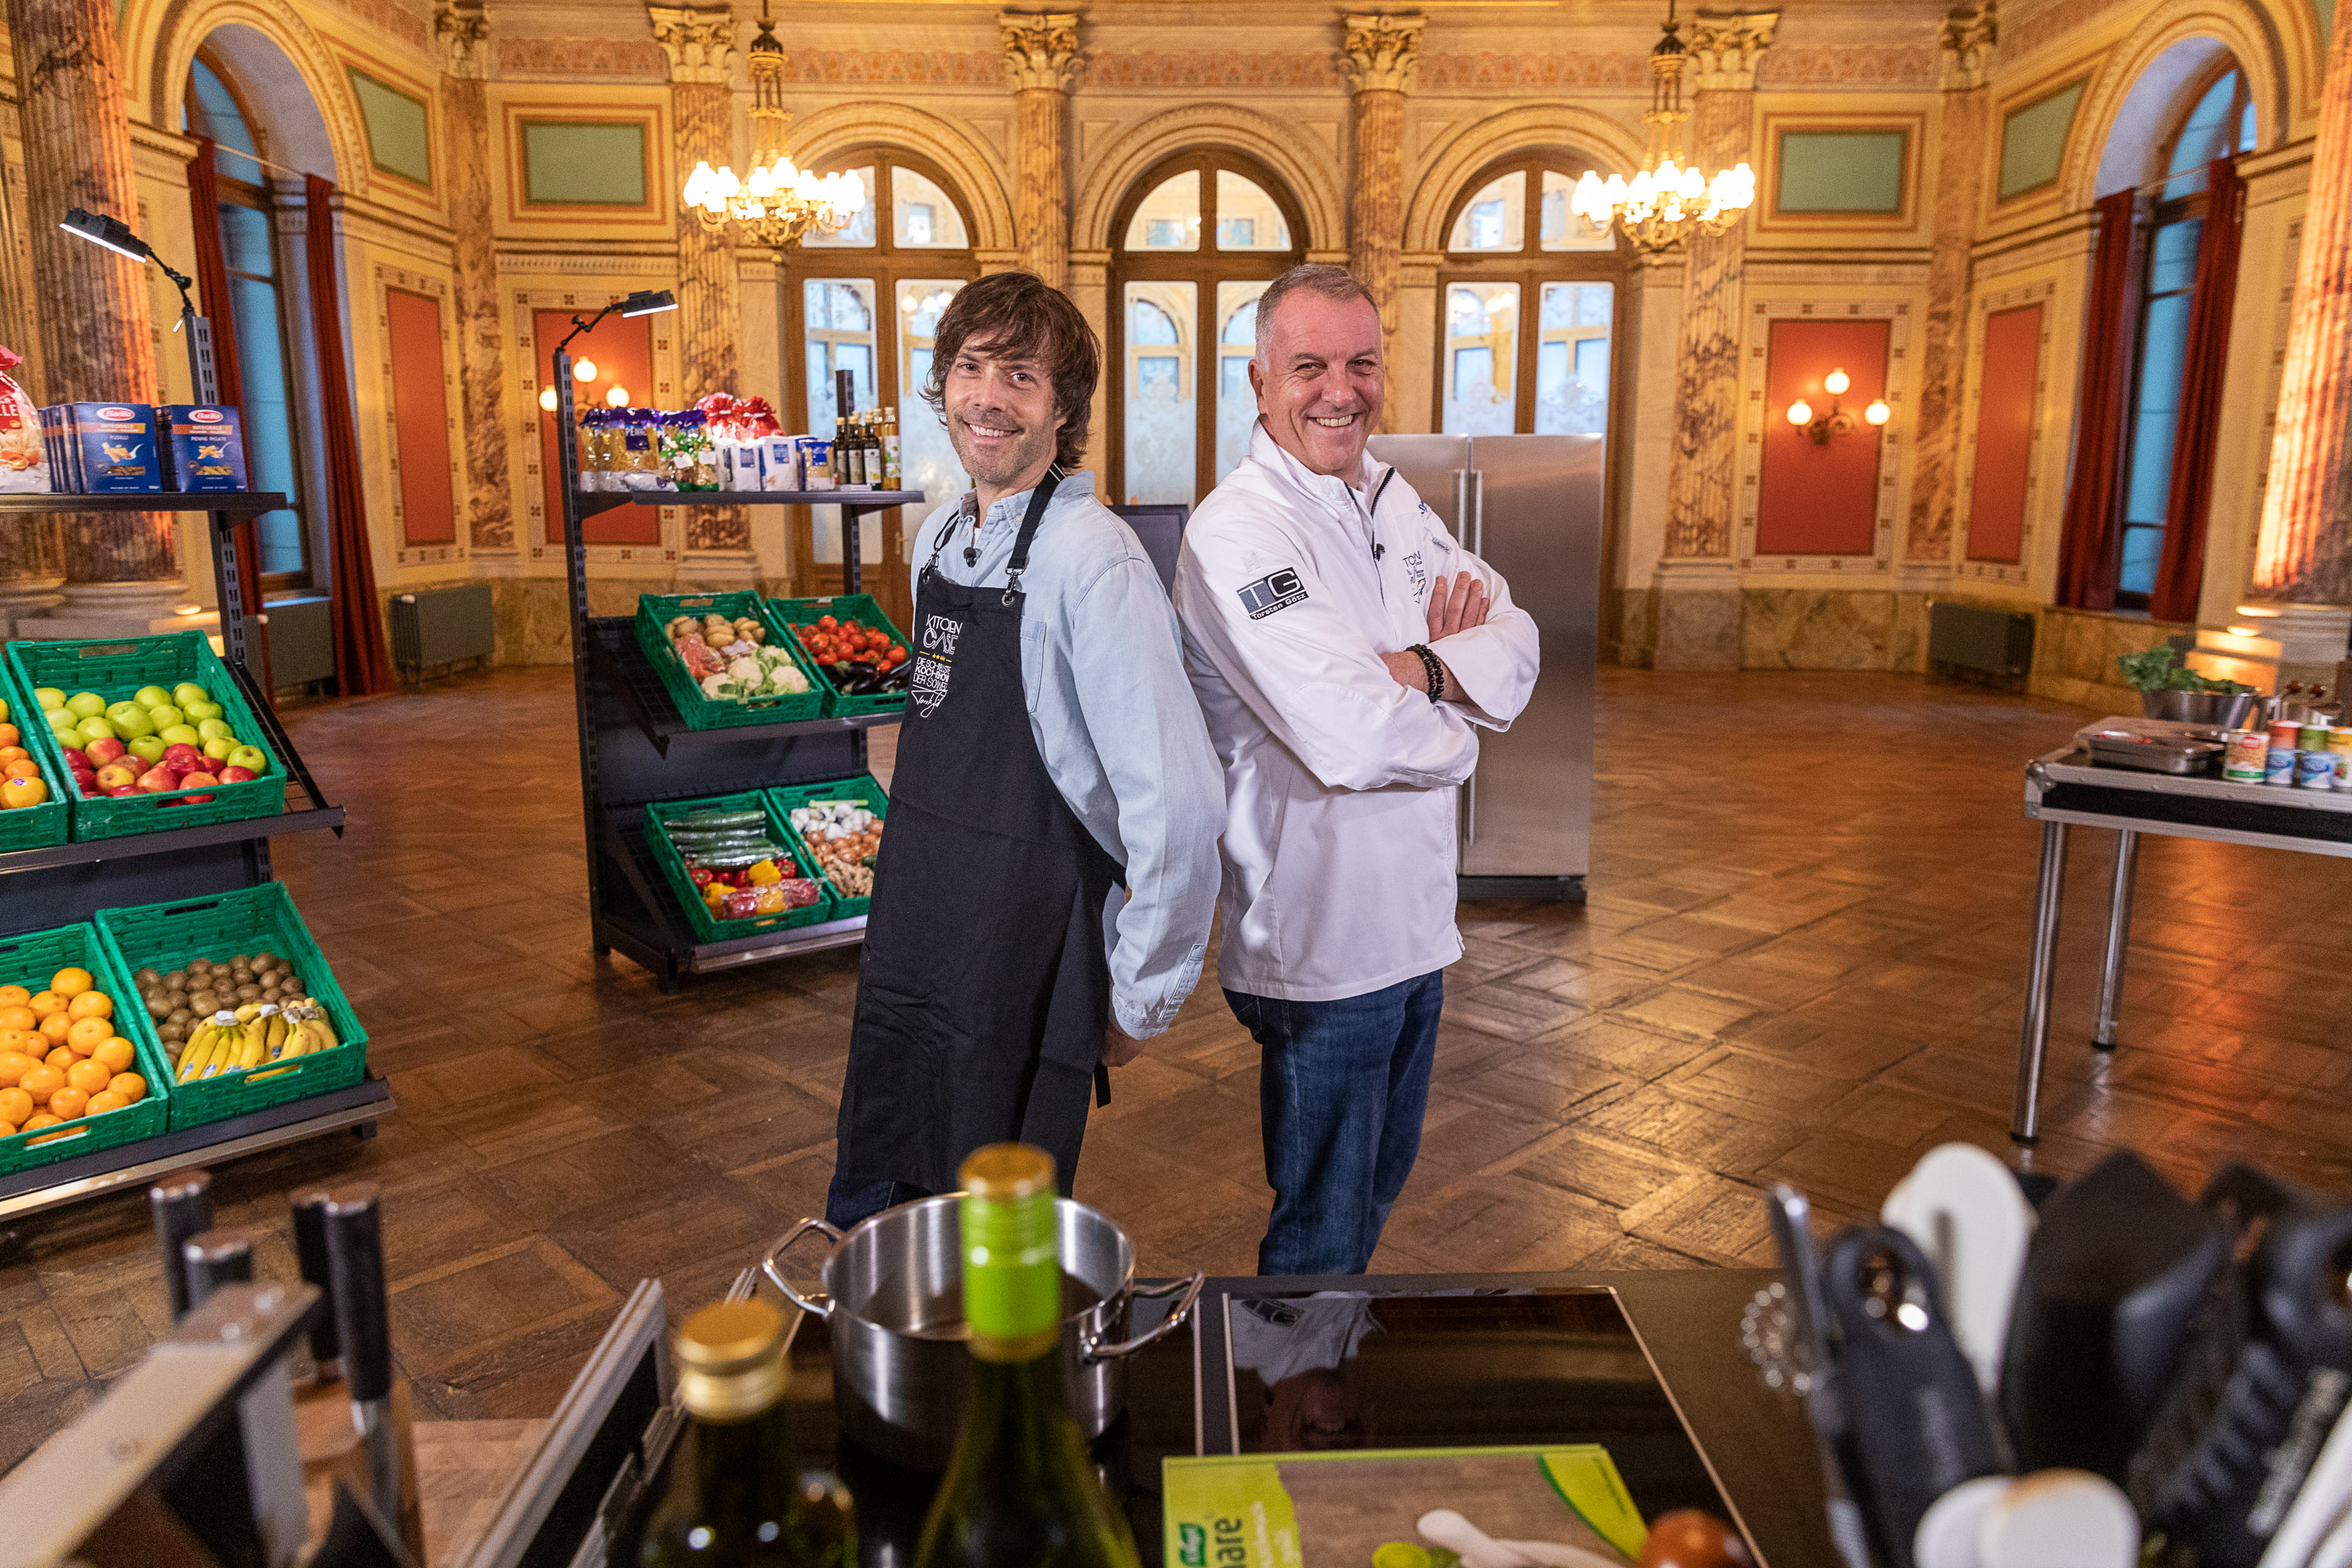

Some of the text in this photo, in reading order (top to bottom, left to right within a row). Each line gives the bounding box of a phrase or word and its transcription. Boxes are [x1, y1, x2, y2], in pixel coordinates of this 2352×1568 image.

[0, 405, 18, 416] LE
[1238, 570, 1301, 608] TG
[1251, 593, 1306, 619] Torsten Götz
[913, 673, 927, 685] DER
[1214, 1517, 1247, 1568] are
